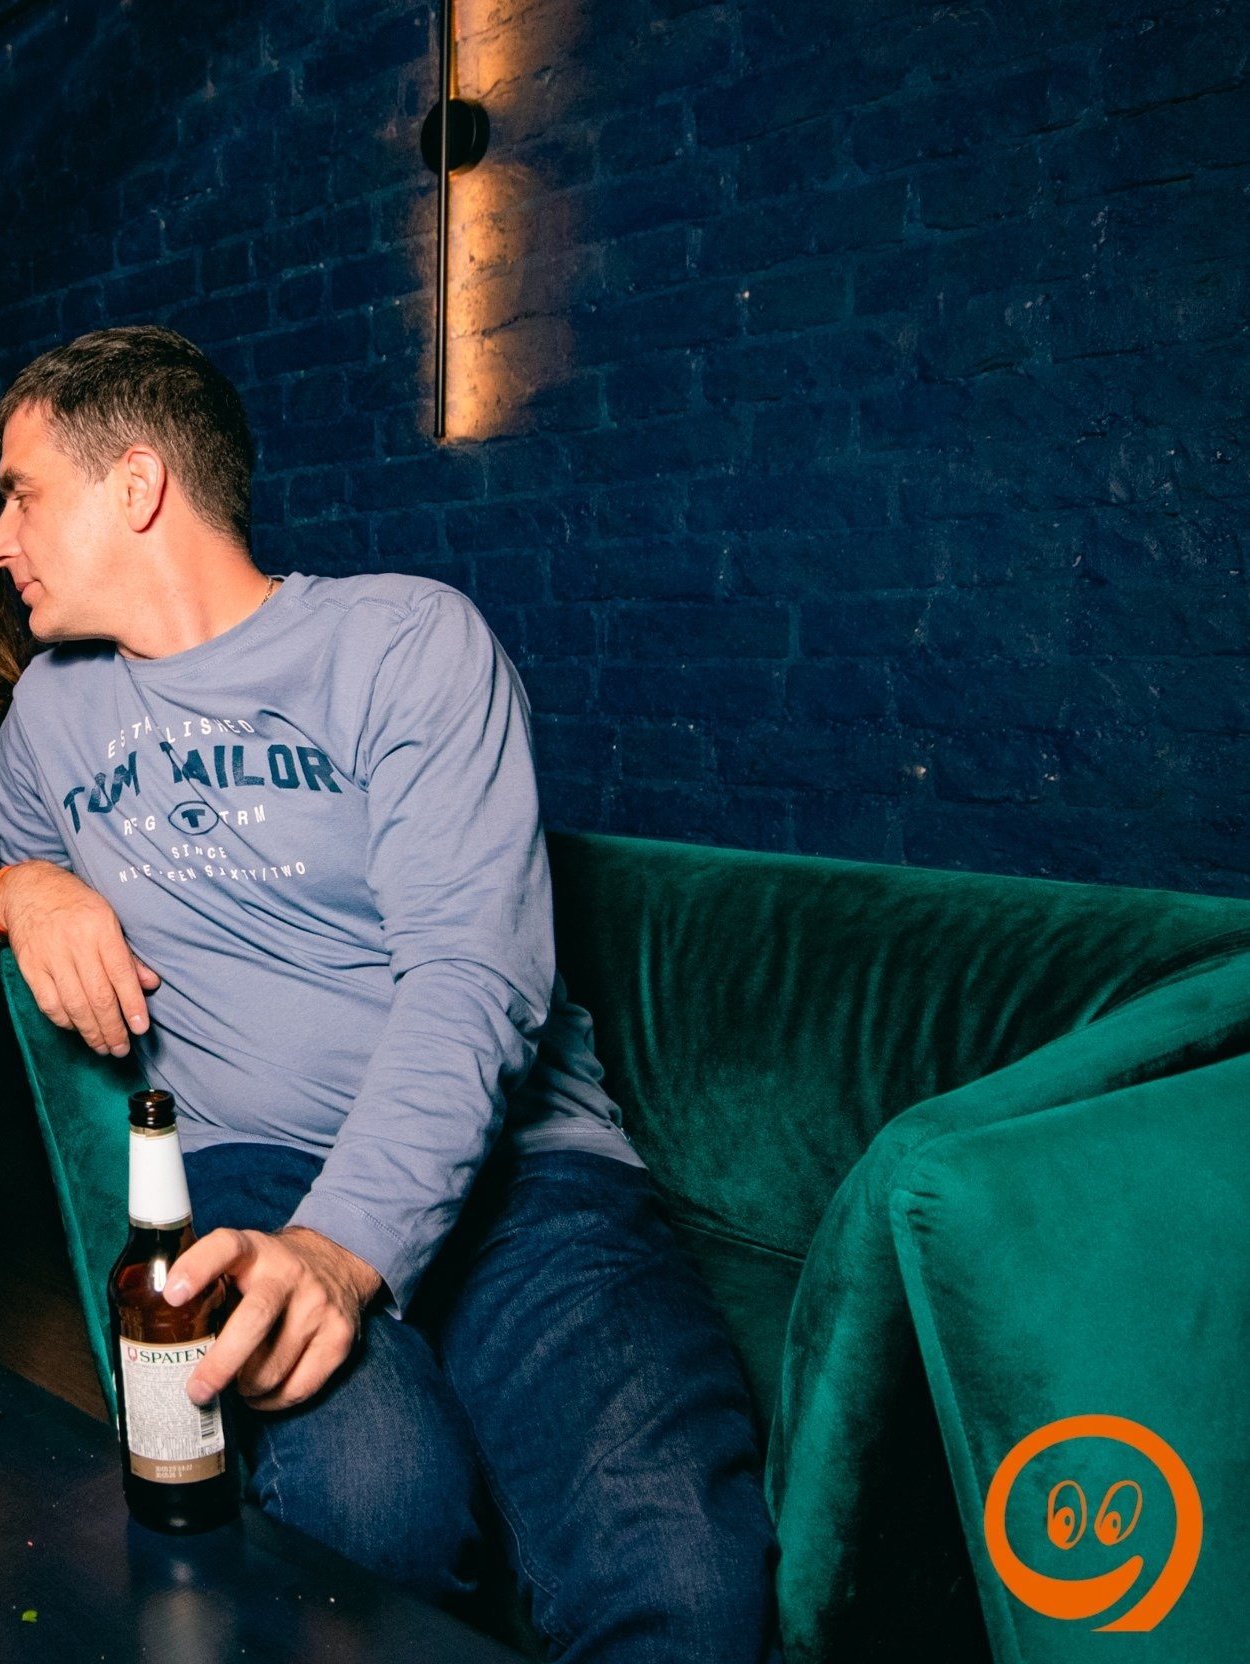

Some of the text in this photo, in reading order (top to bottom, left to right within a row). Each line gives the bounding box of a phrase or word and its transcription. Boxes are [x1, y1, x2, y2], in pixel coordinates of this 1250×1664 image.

[108, 716, 255, 759] ESTALISHED
[118, 863, 197, 883] NIEEEN
[139, 1345, 208, 1364] SPATEN
